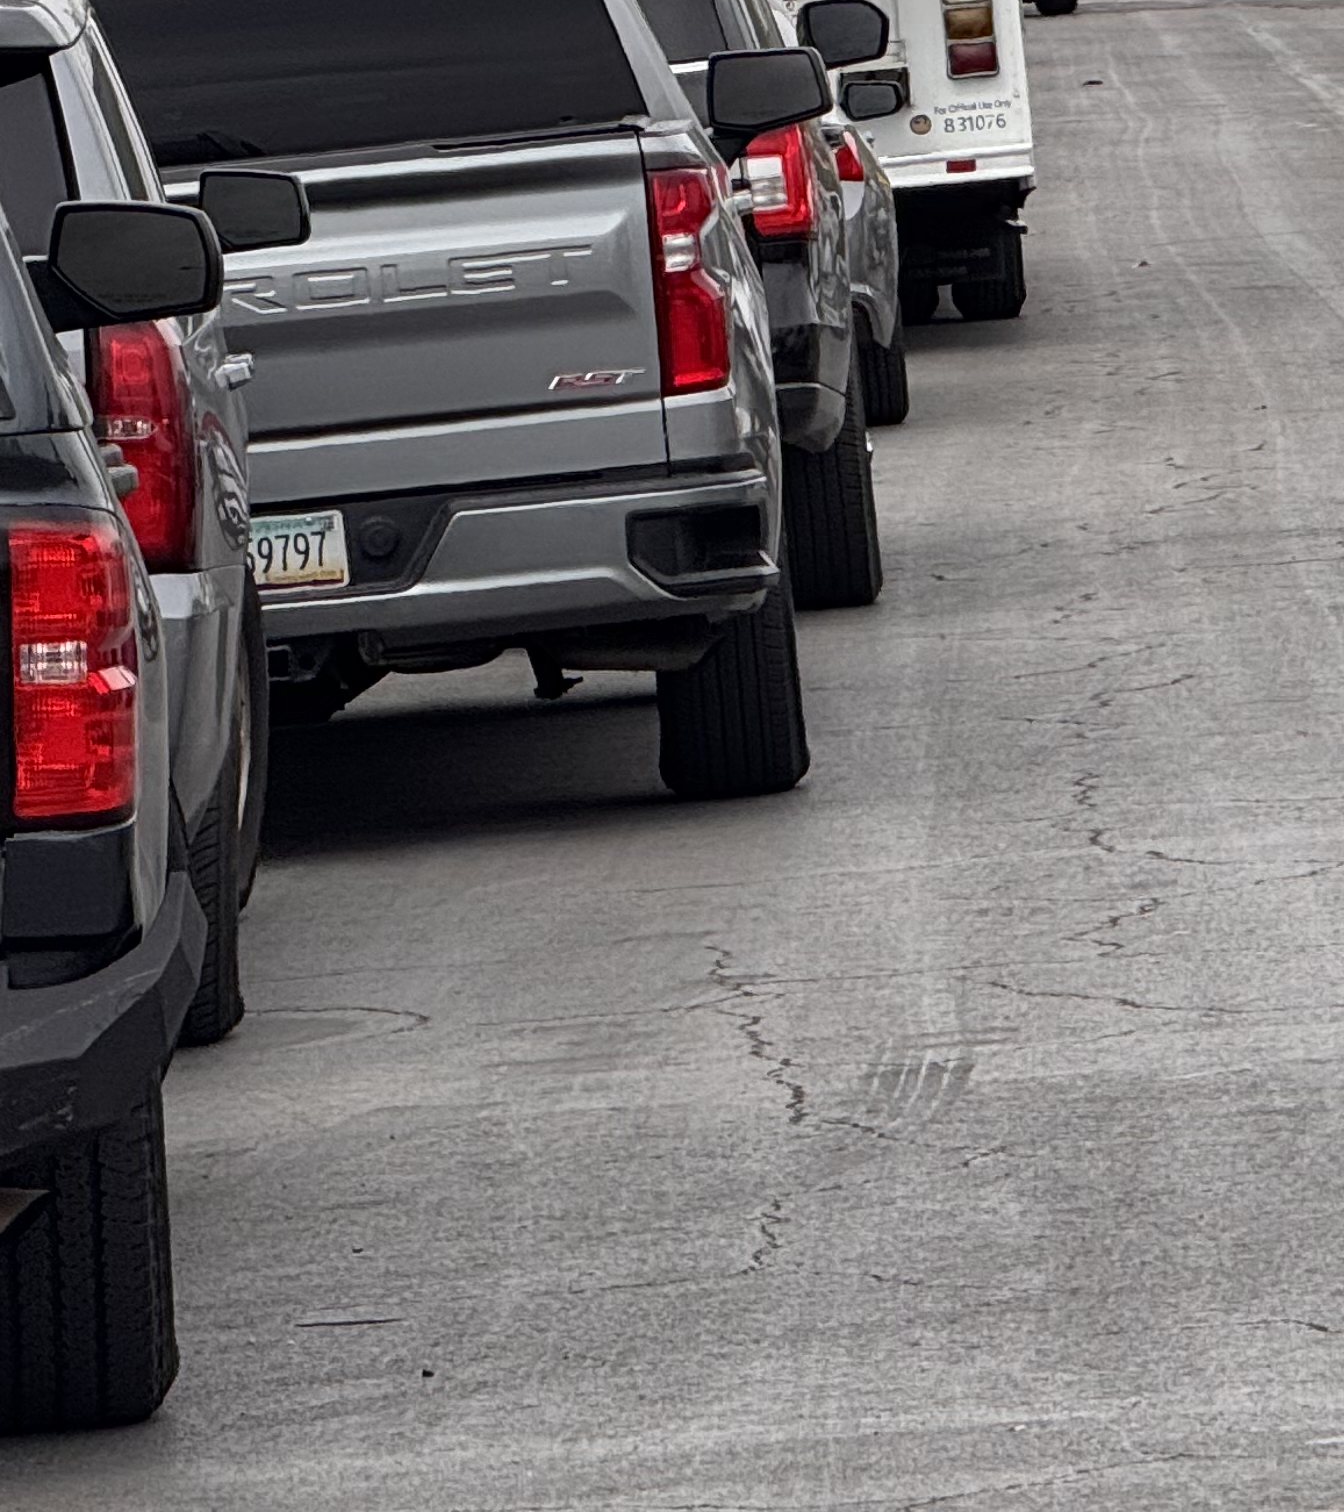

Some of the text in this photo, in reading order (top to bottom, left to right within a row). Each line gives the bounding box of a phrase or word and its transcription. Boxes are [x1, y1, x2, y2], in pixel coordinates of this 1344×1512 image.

[944, 113, 1006, 133] 831076
[223, 245, 593, 315] ROLET
[548, 368, 646, 390] RST
